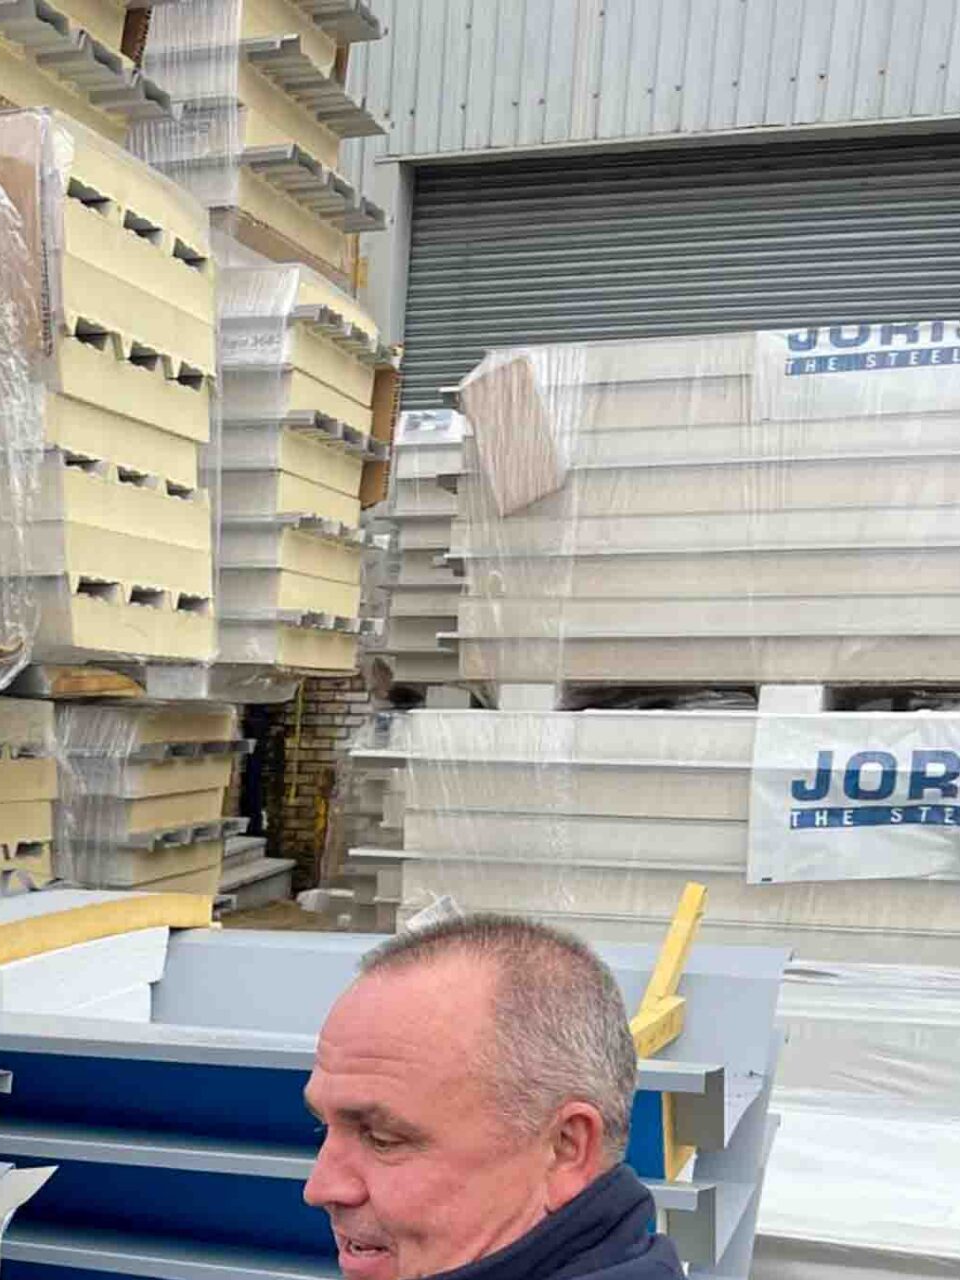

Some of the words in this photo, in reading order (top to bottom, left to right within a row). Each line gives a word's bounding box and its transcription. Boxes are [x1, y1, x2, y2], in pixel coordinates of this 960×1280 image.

[785, 357, 838, 374] THE
[865, 349, 960, 369] STEEL
[792, 810, 854, 827] THE
